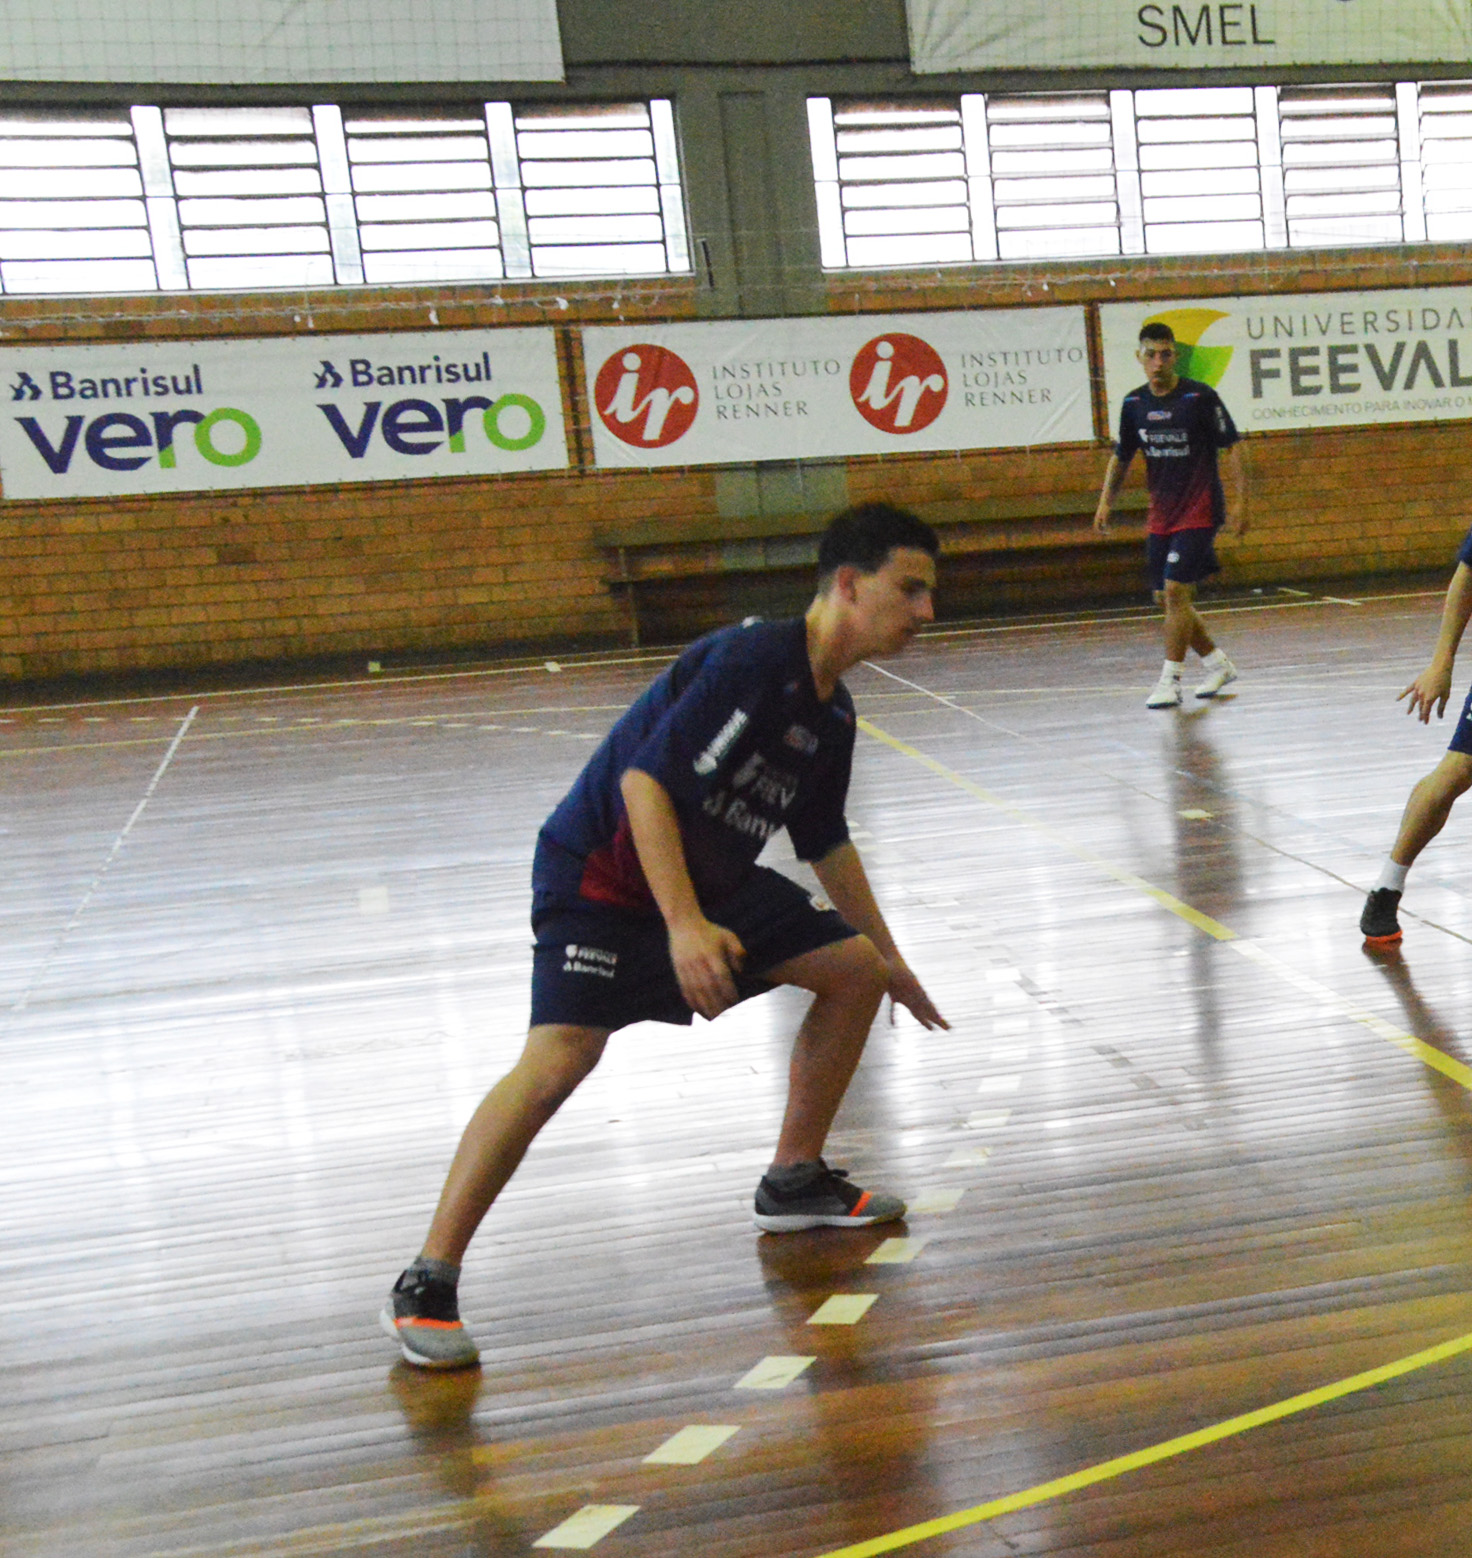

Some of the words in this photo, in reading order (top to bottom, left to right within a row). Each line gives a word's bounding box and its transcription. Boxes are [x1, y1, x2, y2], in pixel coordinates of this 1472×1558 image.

[1137, 4, 1276, 48] SMEL
[961, 347, 1083, 369] INSTITUTO
[349, 352, 492, 388] Banrisul
[712, 359, 841, 380] INSTITUTO
[962, 370, 1028, 388] LOJAS
[49, 364, 203, 400] Banrisul
[714, 381, 783, 400] LOJAS
[964, 388, 1052, 408] RENNER
[716, 400, 809, 421] RENNER
[1252, 403, 1362, 420] CONHECIMENTO
[1364, 401, 1400, 412] PARA
[316, 393, 546, 459] vero
[14, 407, 262, 474] vero
